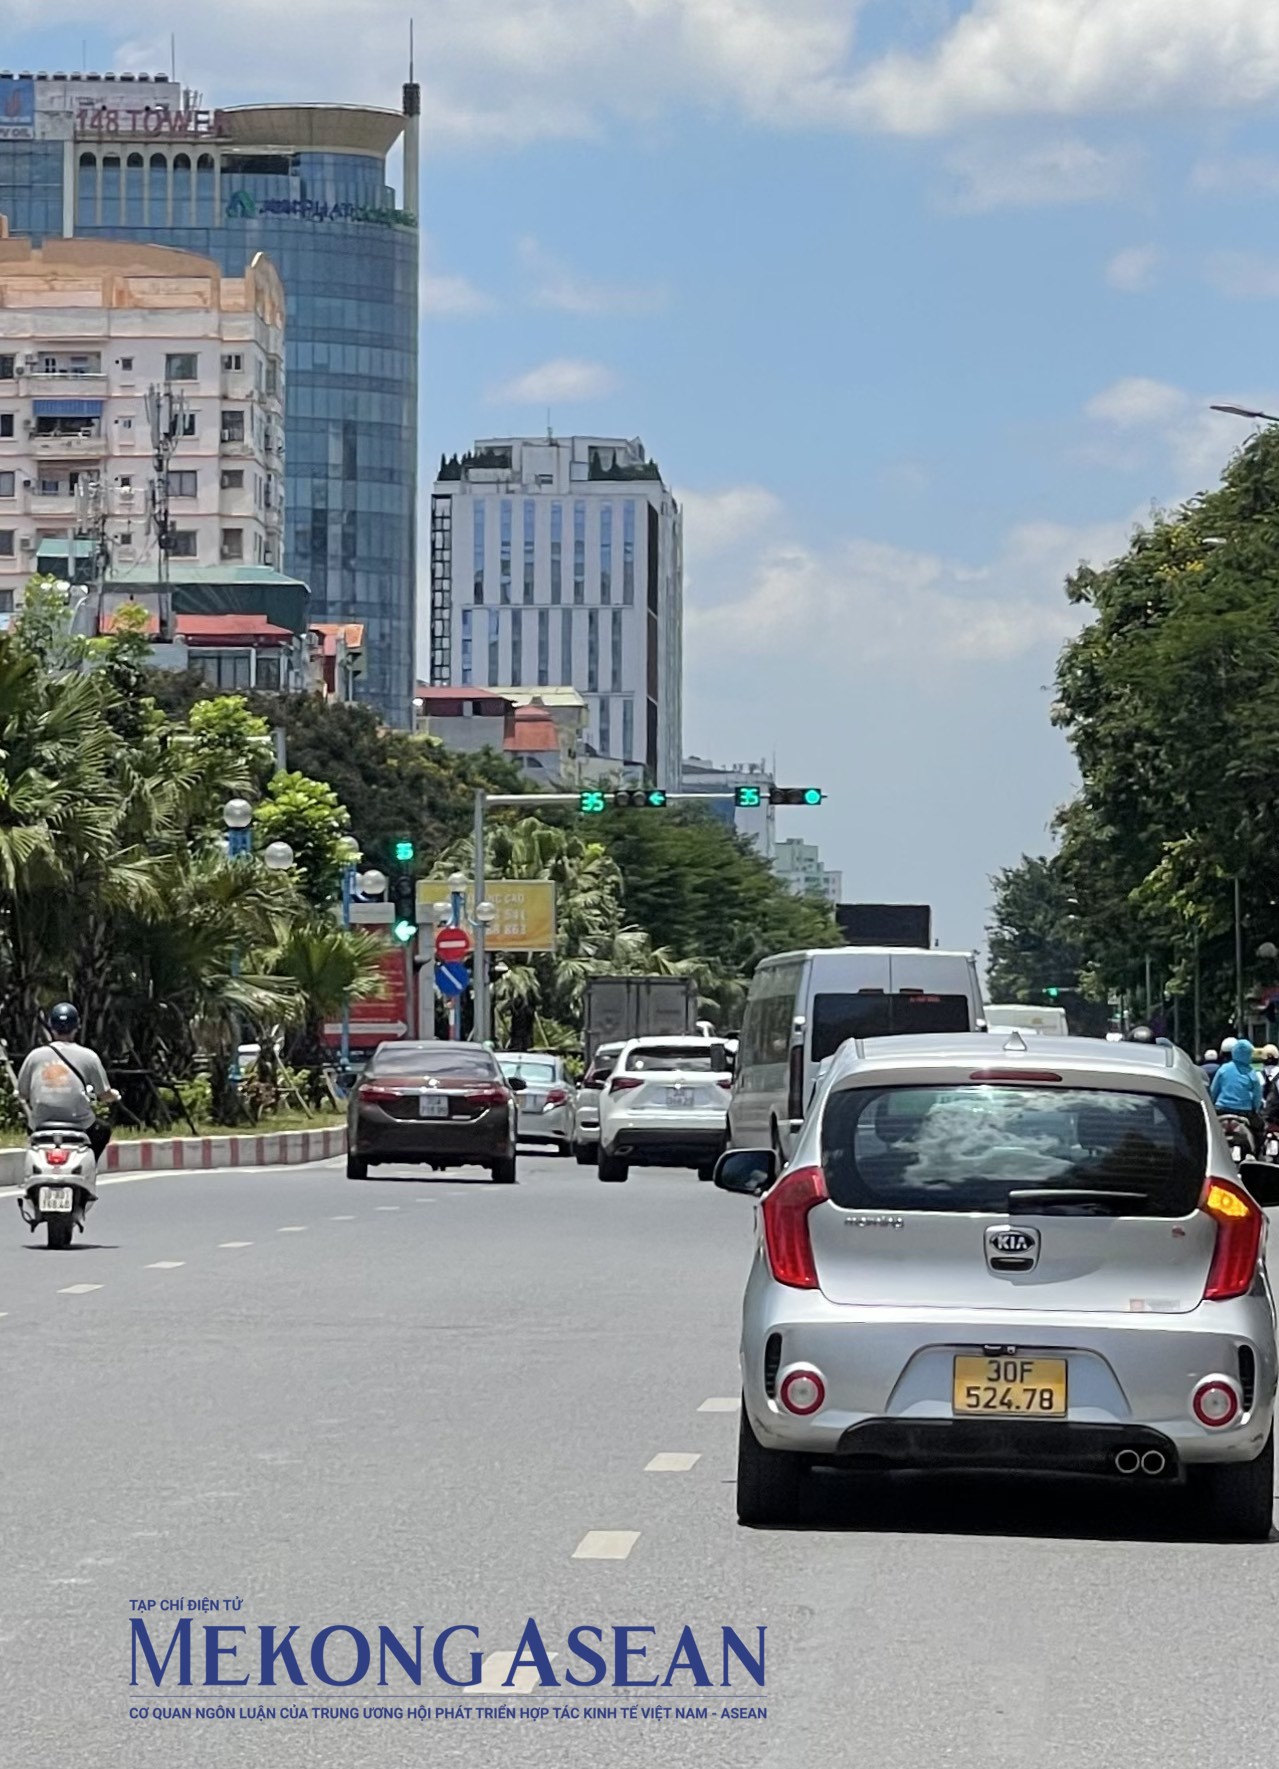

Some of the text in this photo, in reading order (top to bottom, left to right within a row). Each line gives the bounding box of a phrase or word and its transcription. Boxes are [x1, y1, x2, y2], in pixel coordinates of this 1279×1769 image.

[76, 109, 119, 134] 148
[580, 792, 605, 812] 35
[740, 787, 760, 806] 35
[996, 1235, 1029, 1250] KIA
[987, 1360, 1034, 1383] 30F
[965, 1385, 1054, 1411] 524.78
